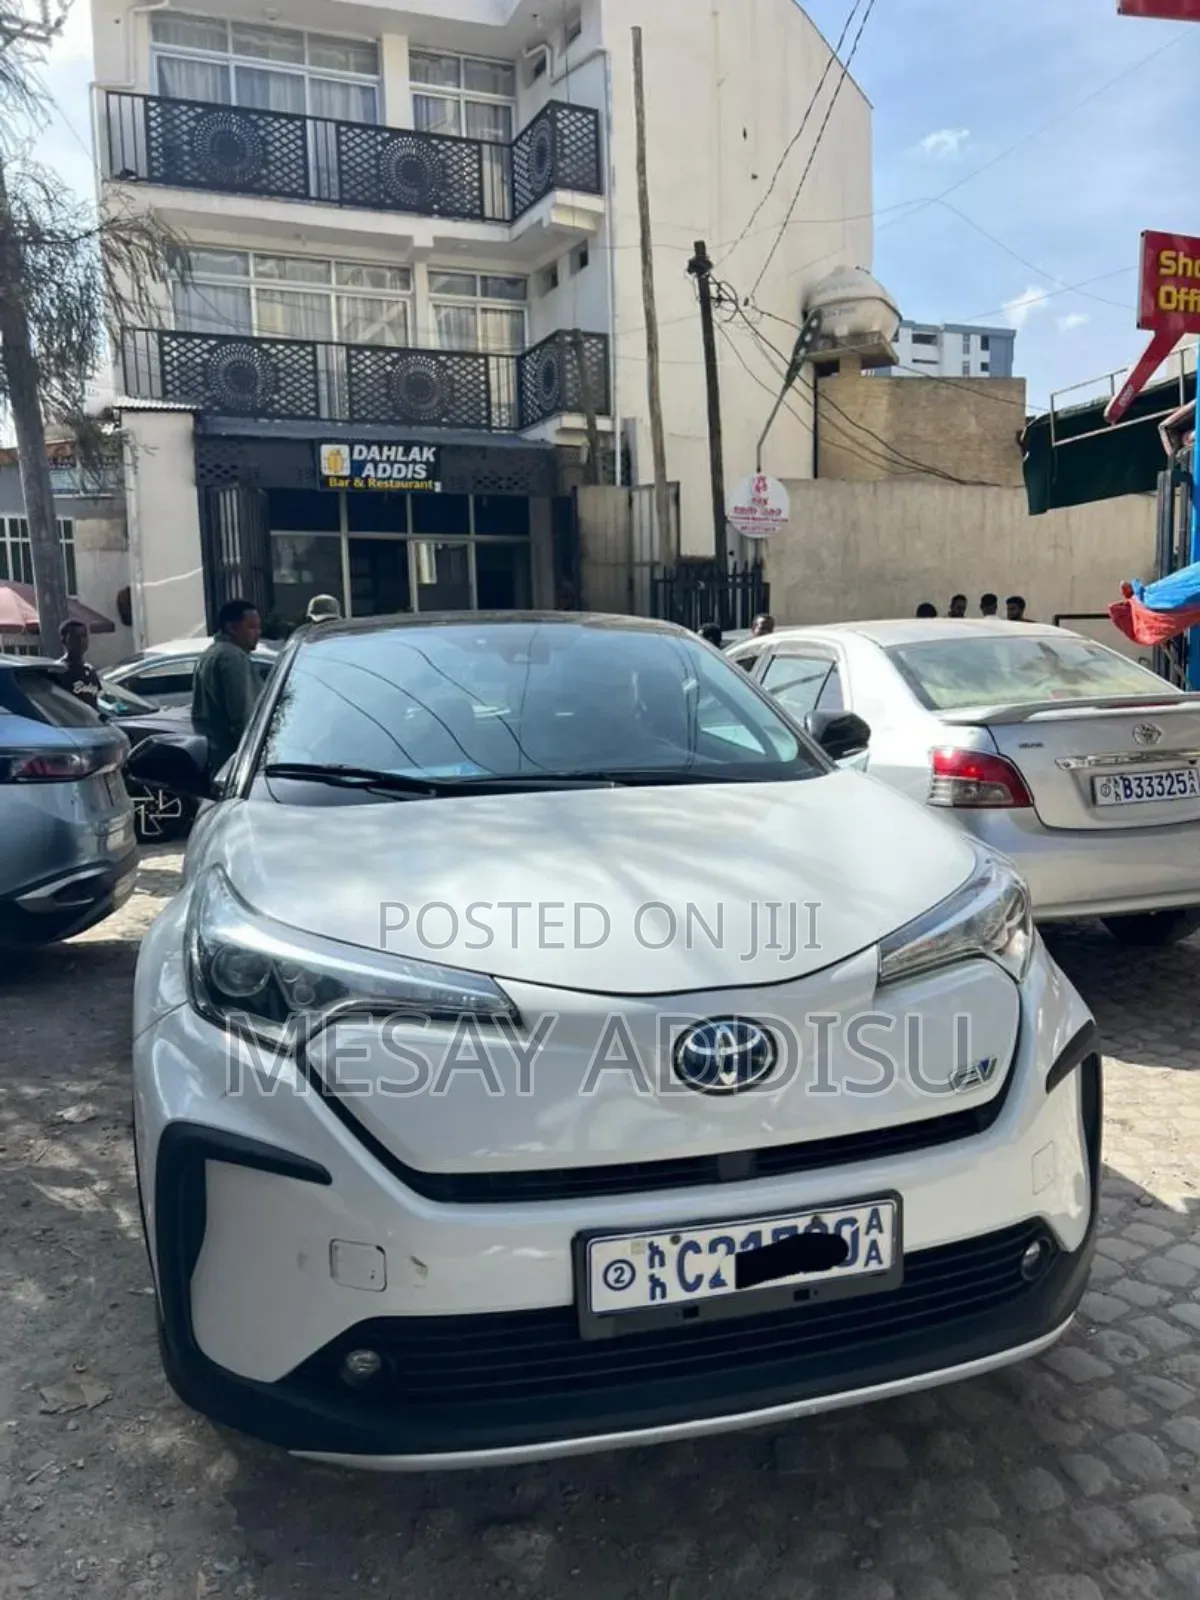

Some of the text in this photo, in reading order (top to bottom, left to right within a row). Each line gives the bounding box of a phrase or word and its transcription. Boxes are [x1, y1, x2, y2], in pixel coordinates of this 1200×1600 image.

[352, 444, 436, 462] DAHLAK
[361, 462, 427, 479] ADDIS
[328, 477, 433, 490] Bar & Restaurant
[1122, 772, 1187, 799] B33325
